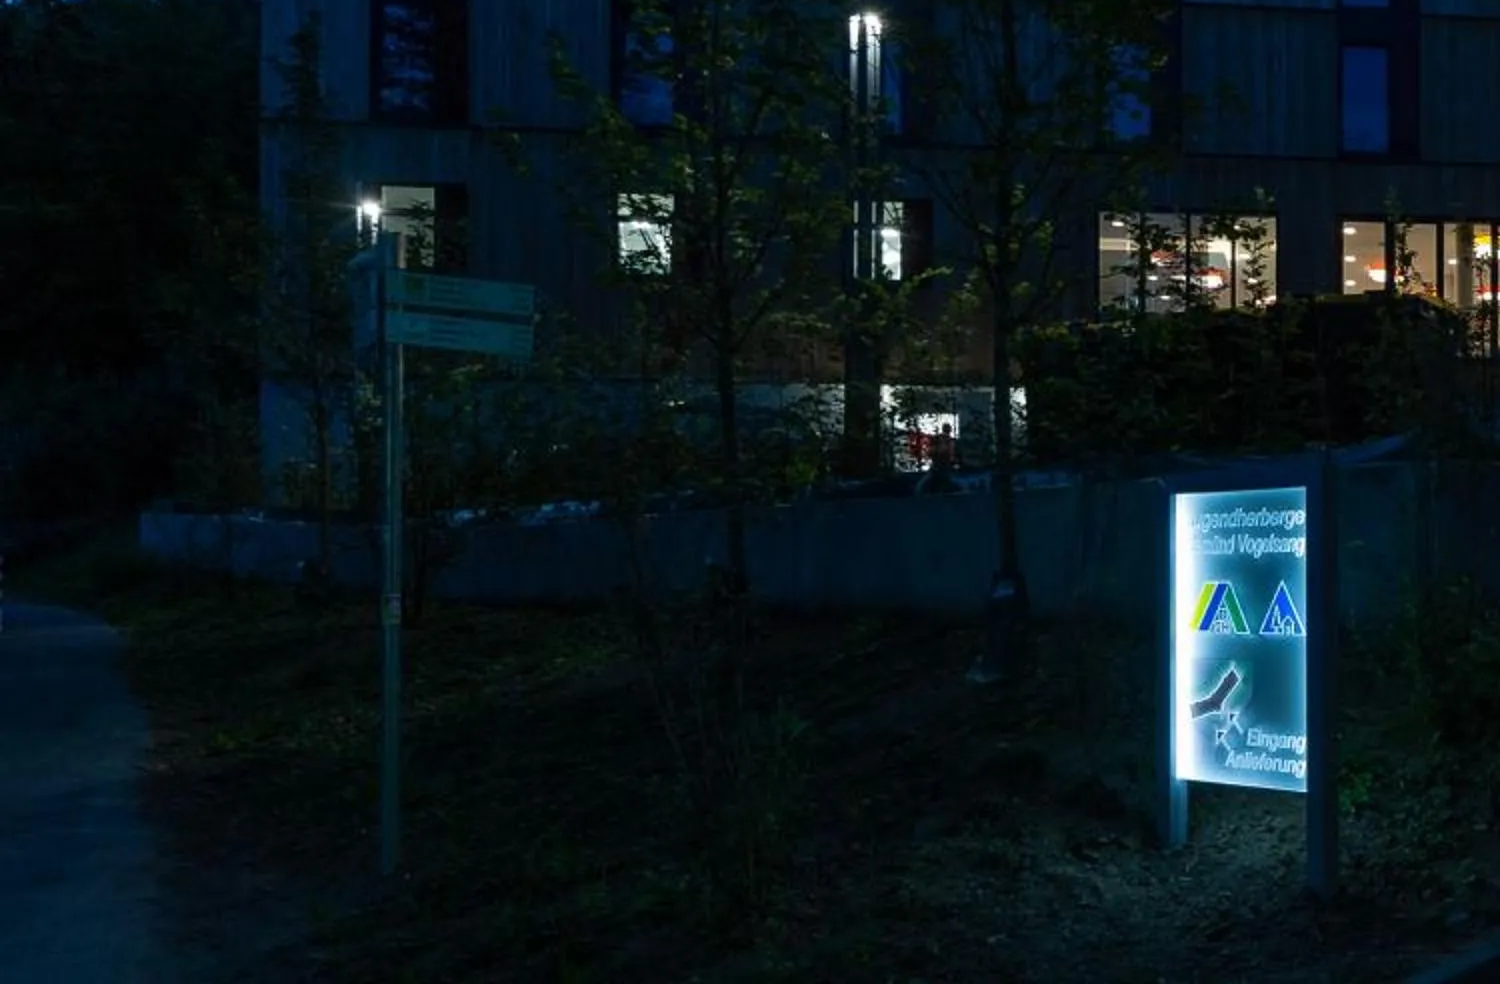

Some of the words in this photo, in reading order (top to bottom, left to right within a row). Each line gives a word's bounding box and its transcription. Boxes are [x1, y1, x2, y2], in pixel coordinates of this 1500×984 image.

[1238, 533, 1306, 559] Vogelsang
[1245, 727, 1306, 755] Eingang
[1225, 749, 1306, 779] Anlieferung
